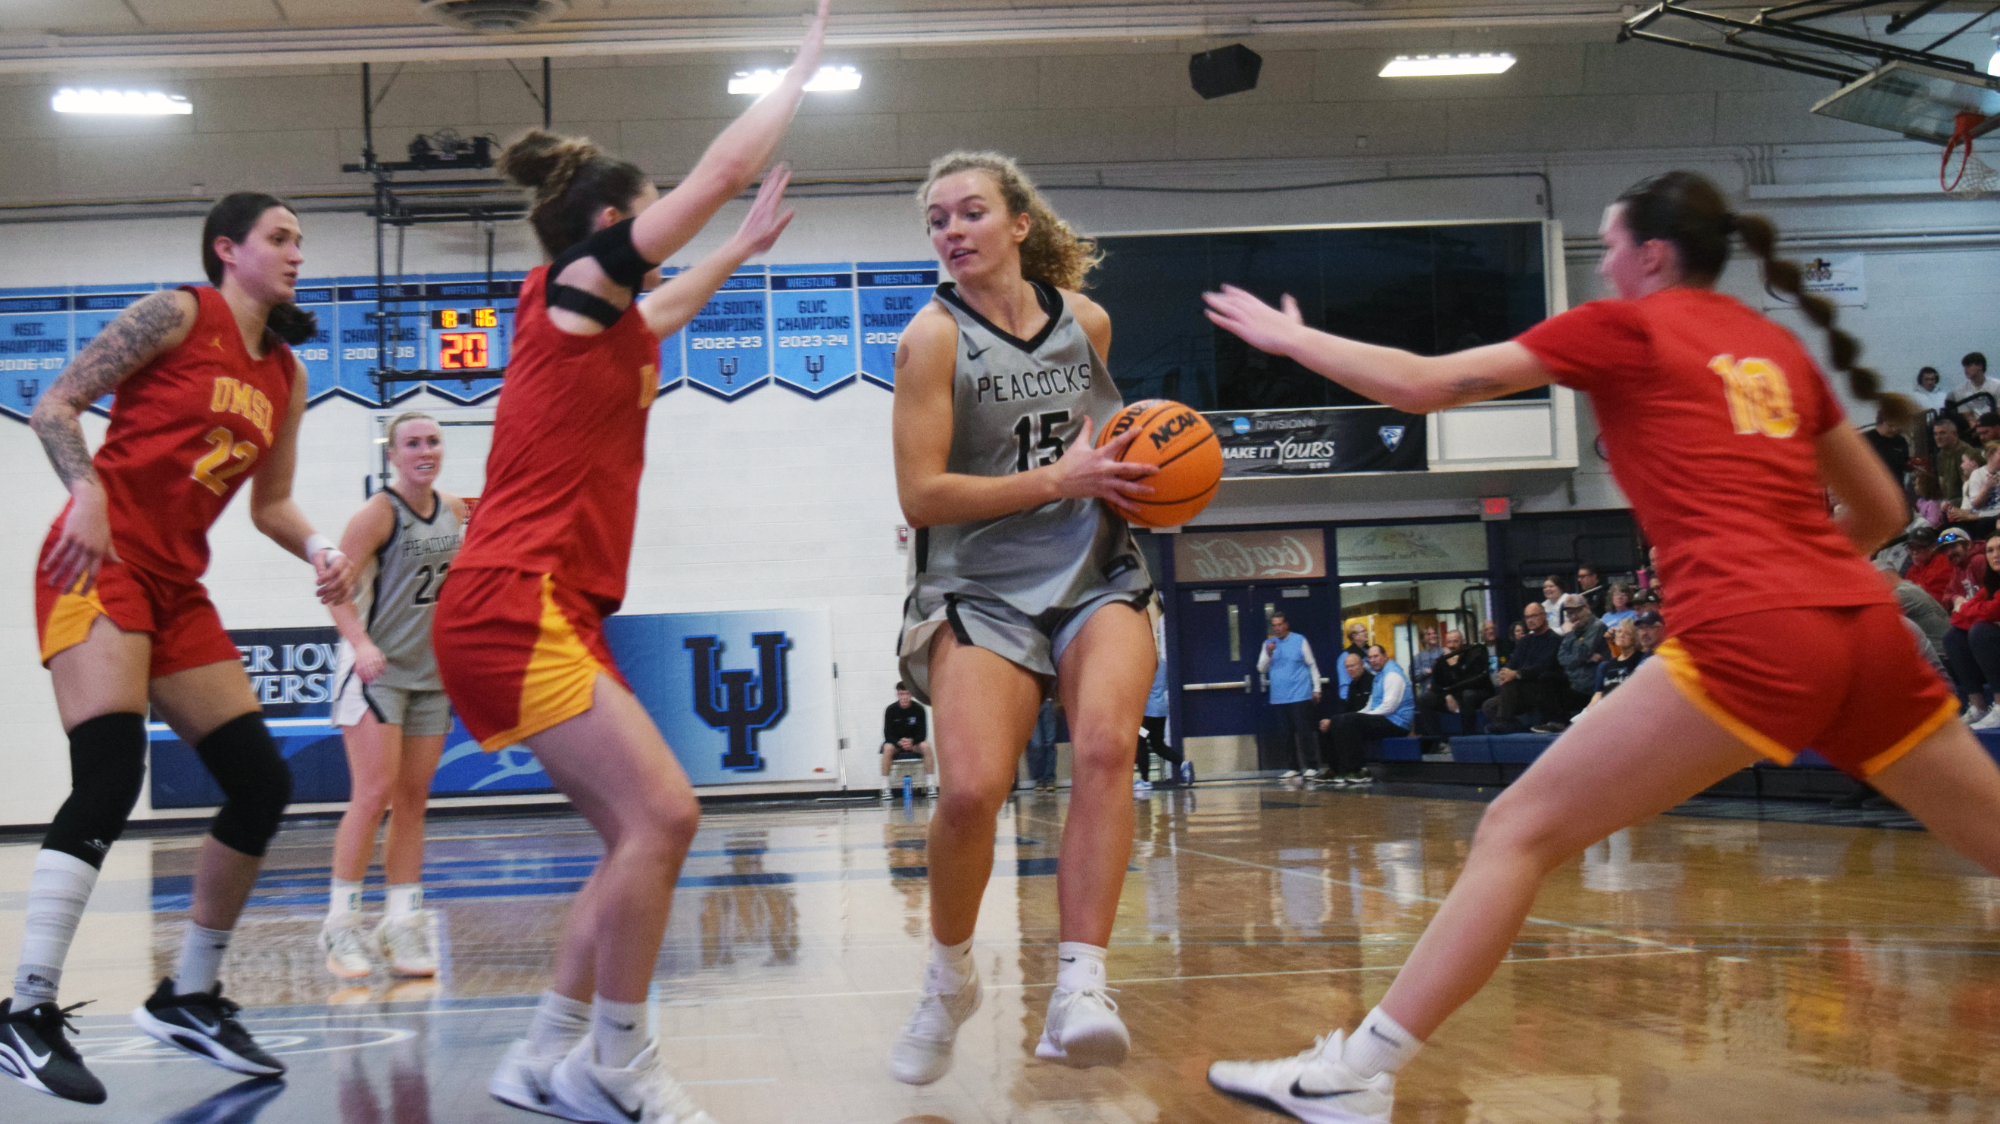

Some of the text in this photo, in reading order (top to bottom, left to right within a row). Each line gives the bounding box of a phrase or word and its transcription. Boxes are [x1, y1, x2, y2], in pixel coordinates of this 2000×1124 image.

[785, 277, 837, 288] WRESTLING
[873, 273, 923, 284] WRESTLING
[723, 301, 763, 315] SOUTH
[798, 300, 828, 314] GLVC
[884, 296, 914, 310] GLVC
[441, 309, 459, 329] 8
[689, 317, 765, 333] CHAMPIONS
[777, 315, 850, 331] CHAMPIONS
[691, 335, 763, 350] 2022-23
[778, 334, 849, 348] 2023-24
[440, 332, 489, 370] 20
[976, 363, 1091, 403] PEACOCKS
[1149, 411, 1201, 450] NCAA
[1255, 418, 1307, 430] DIVISION
[1012, 408, 1074, 474] 15
[1259, 446, 1275, 459] IT
[1274, 436, 1336, 465] YOURS
[190, 426, 259, 497] 22
